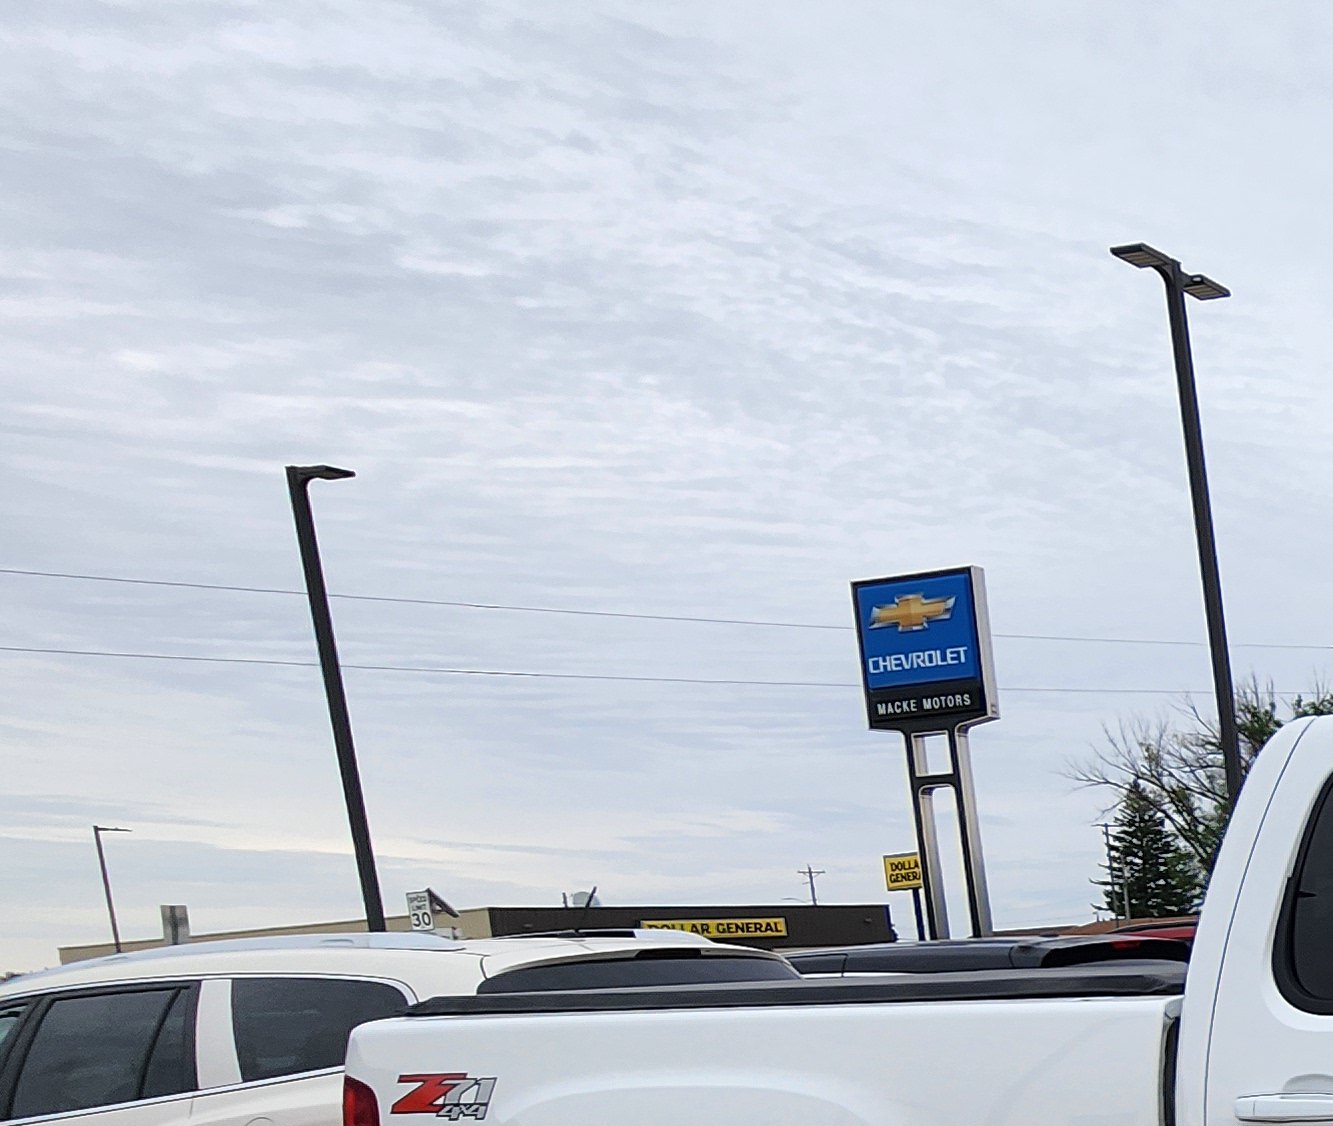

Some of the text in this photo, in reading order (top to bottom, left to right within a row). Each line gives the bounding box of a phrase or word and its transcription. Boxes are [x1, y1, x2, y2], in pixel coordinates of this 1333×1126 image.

[868, 646, 968, 674] CHEVROLET
[877, 693, 972, 715] MACKE MOTORS
[889, 859, 920, 872] DOLLA
[889, 870, 922, 884] GENER
[412, 911, 432, 927] 30
[716, 921, 783, 934] GENERAL
[390, 1072, 498, 1115] Z71
